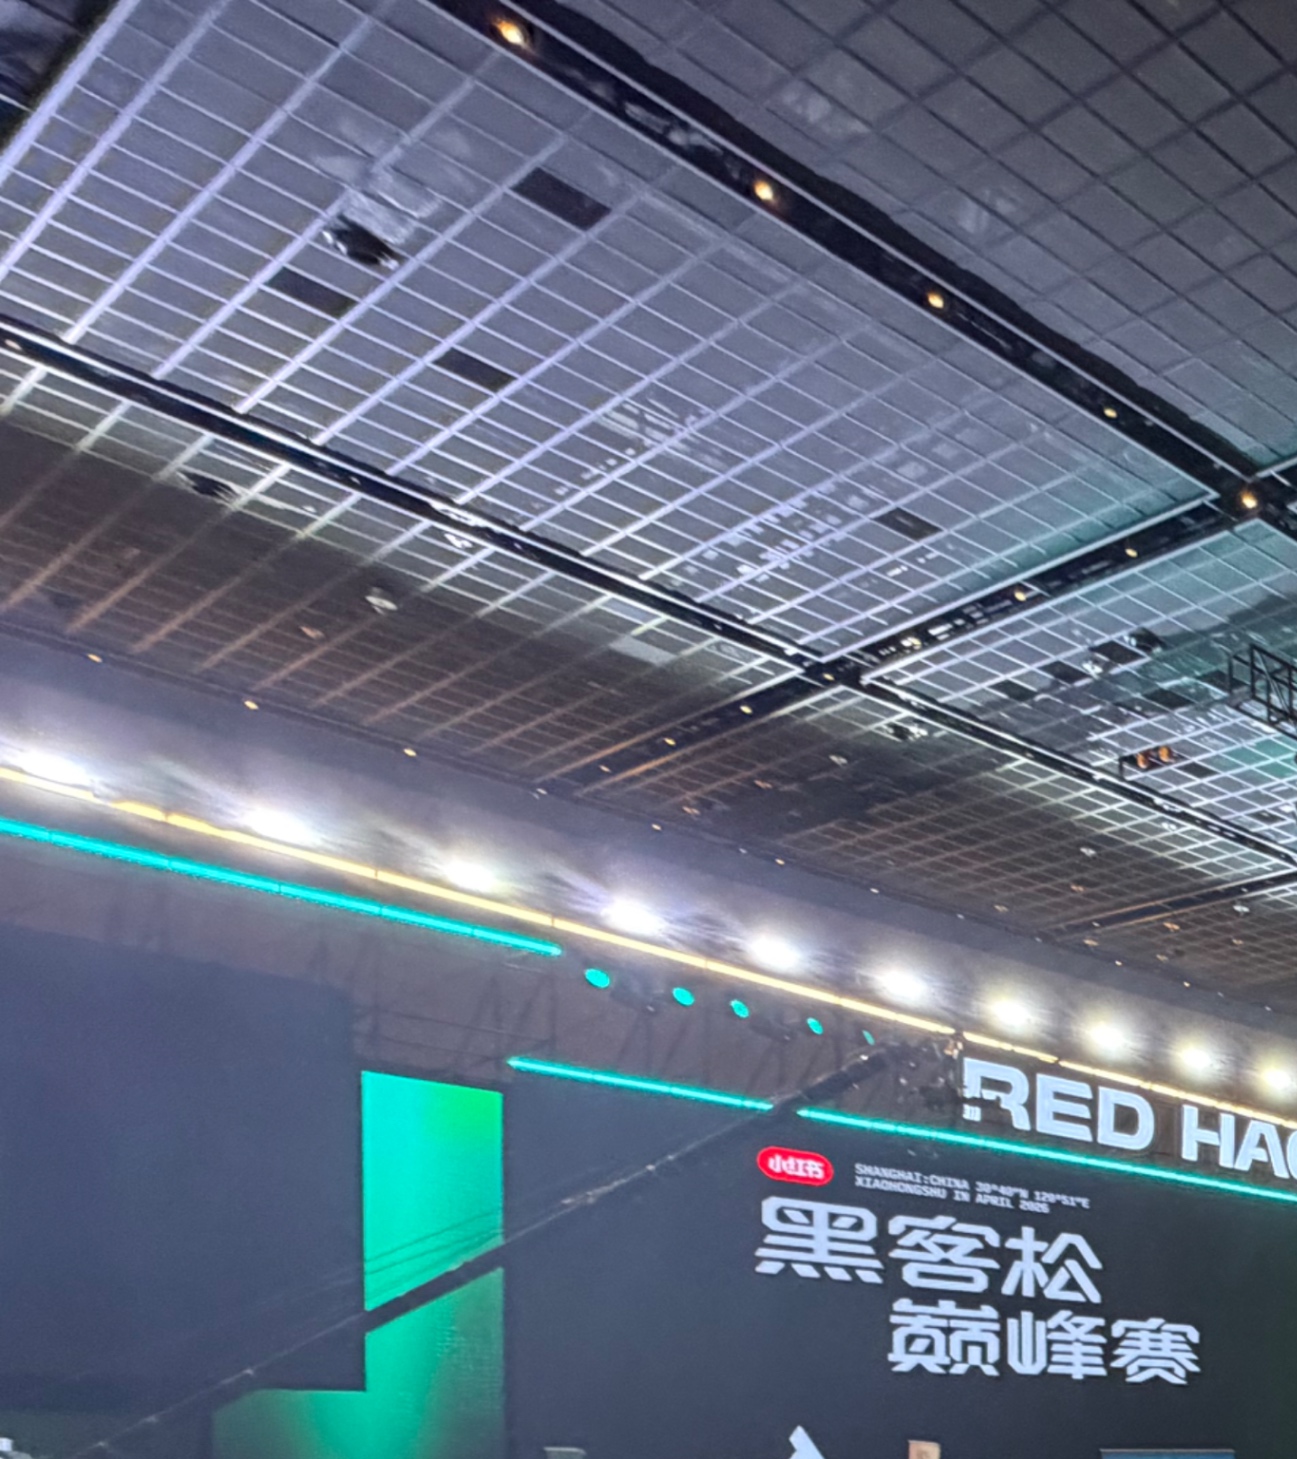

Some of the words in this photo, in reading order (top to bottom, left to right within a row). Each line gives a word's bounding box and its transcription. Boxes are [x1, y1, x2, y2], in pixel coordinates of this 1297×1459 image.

[963, 1057, 1155, 1151] RED
[954, 1189, 970, 1202] IN
[975, 1193, 1015, 1210] APRIL
[755, 1196, 1102, 1303] 黑客松
[887, 1298, 1201, 1385] 巅峰赛
